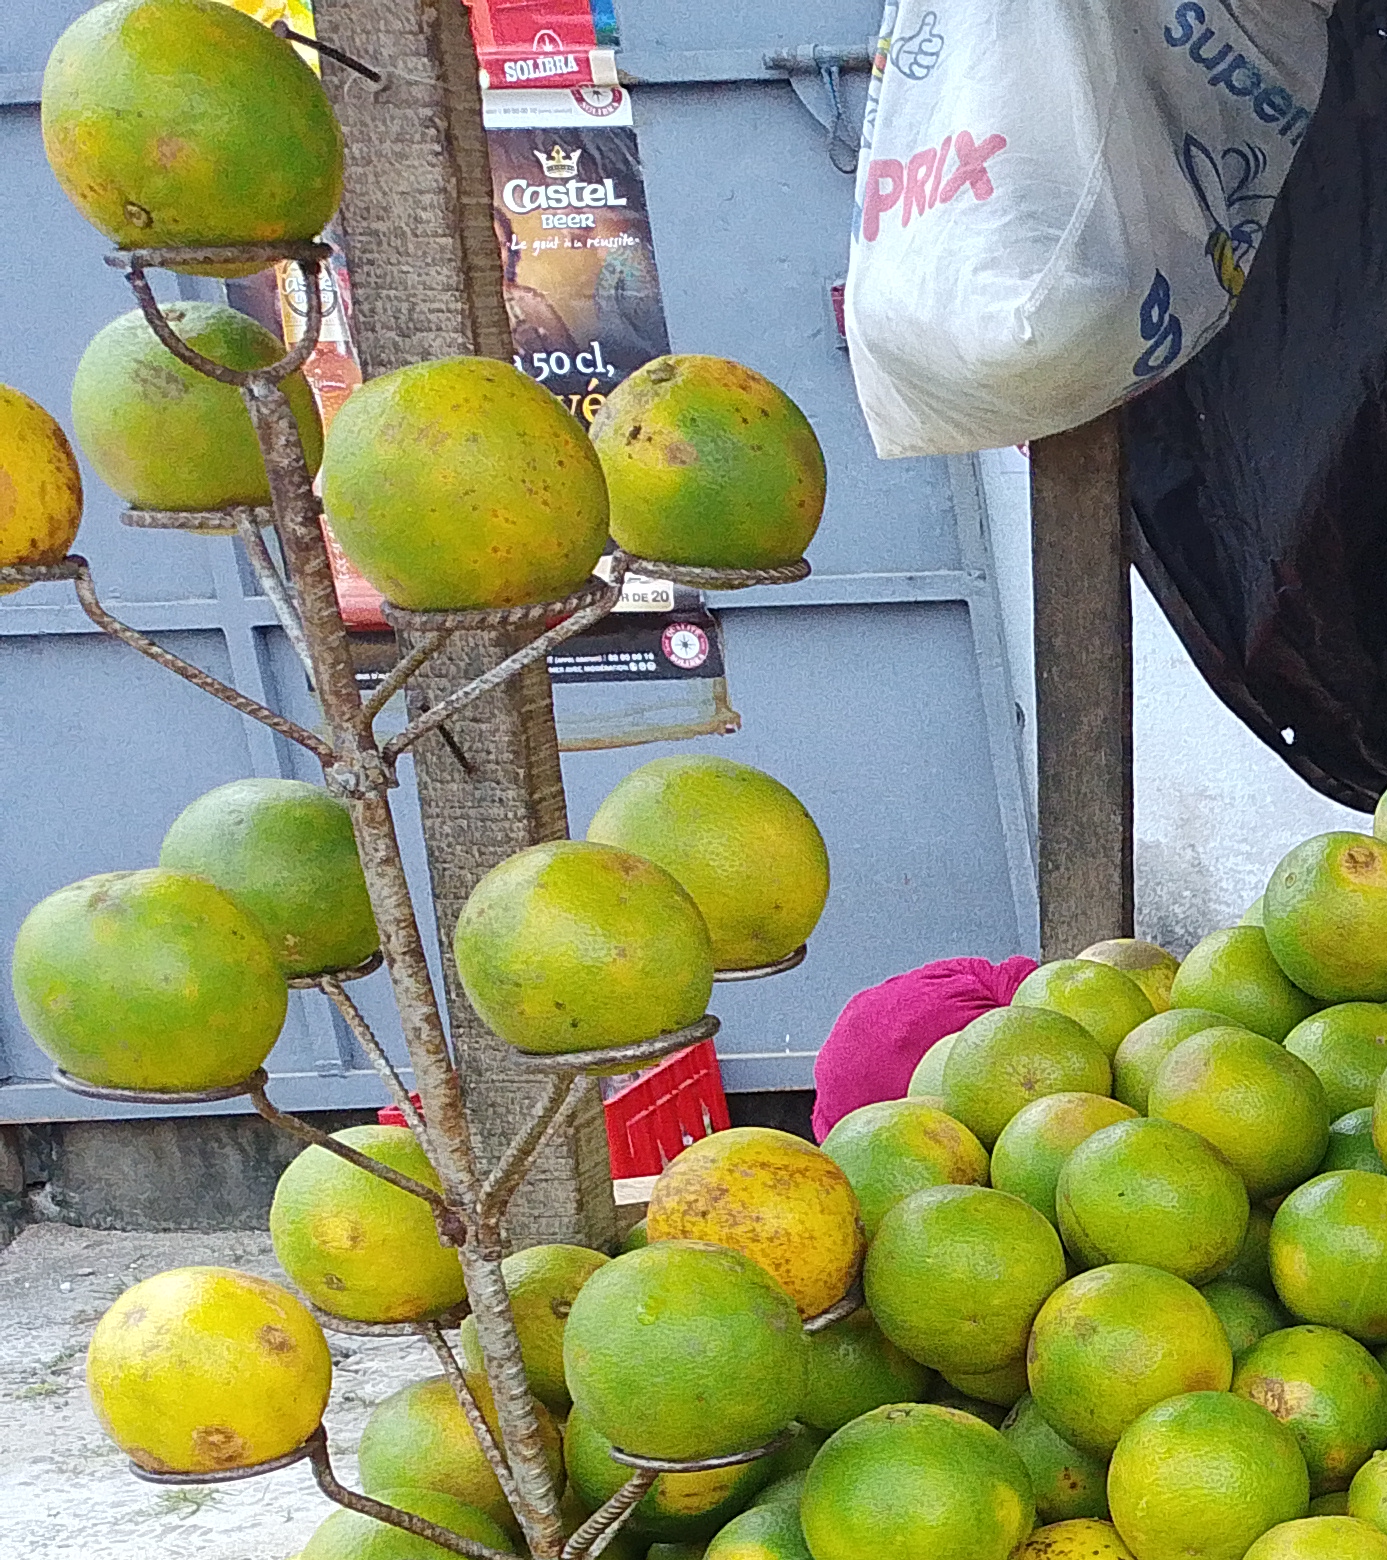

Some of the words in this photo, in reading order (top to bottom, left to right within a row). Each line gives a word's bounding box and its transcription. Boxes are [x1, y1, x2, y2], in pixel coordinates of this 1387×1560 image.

[502, 178, 628, 214] Castel
[862, 130, 1007, 242] PRIX
[541, 213, 596, 229] BEER
[532, 351, 571, 382] 50
[575, 340, 615, 378] cl,
[633, 592, 649, 603] DE
[651, 590, 670, 603] 20
